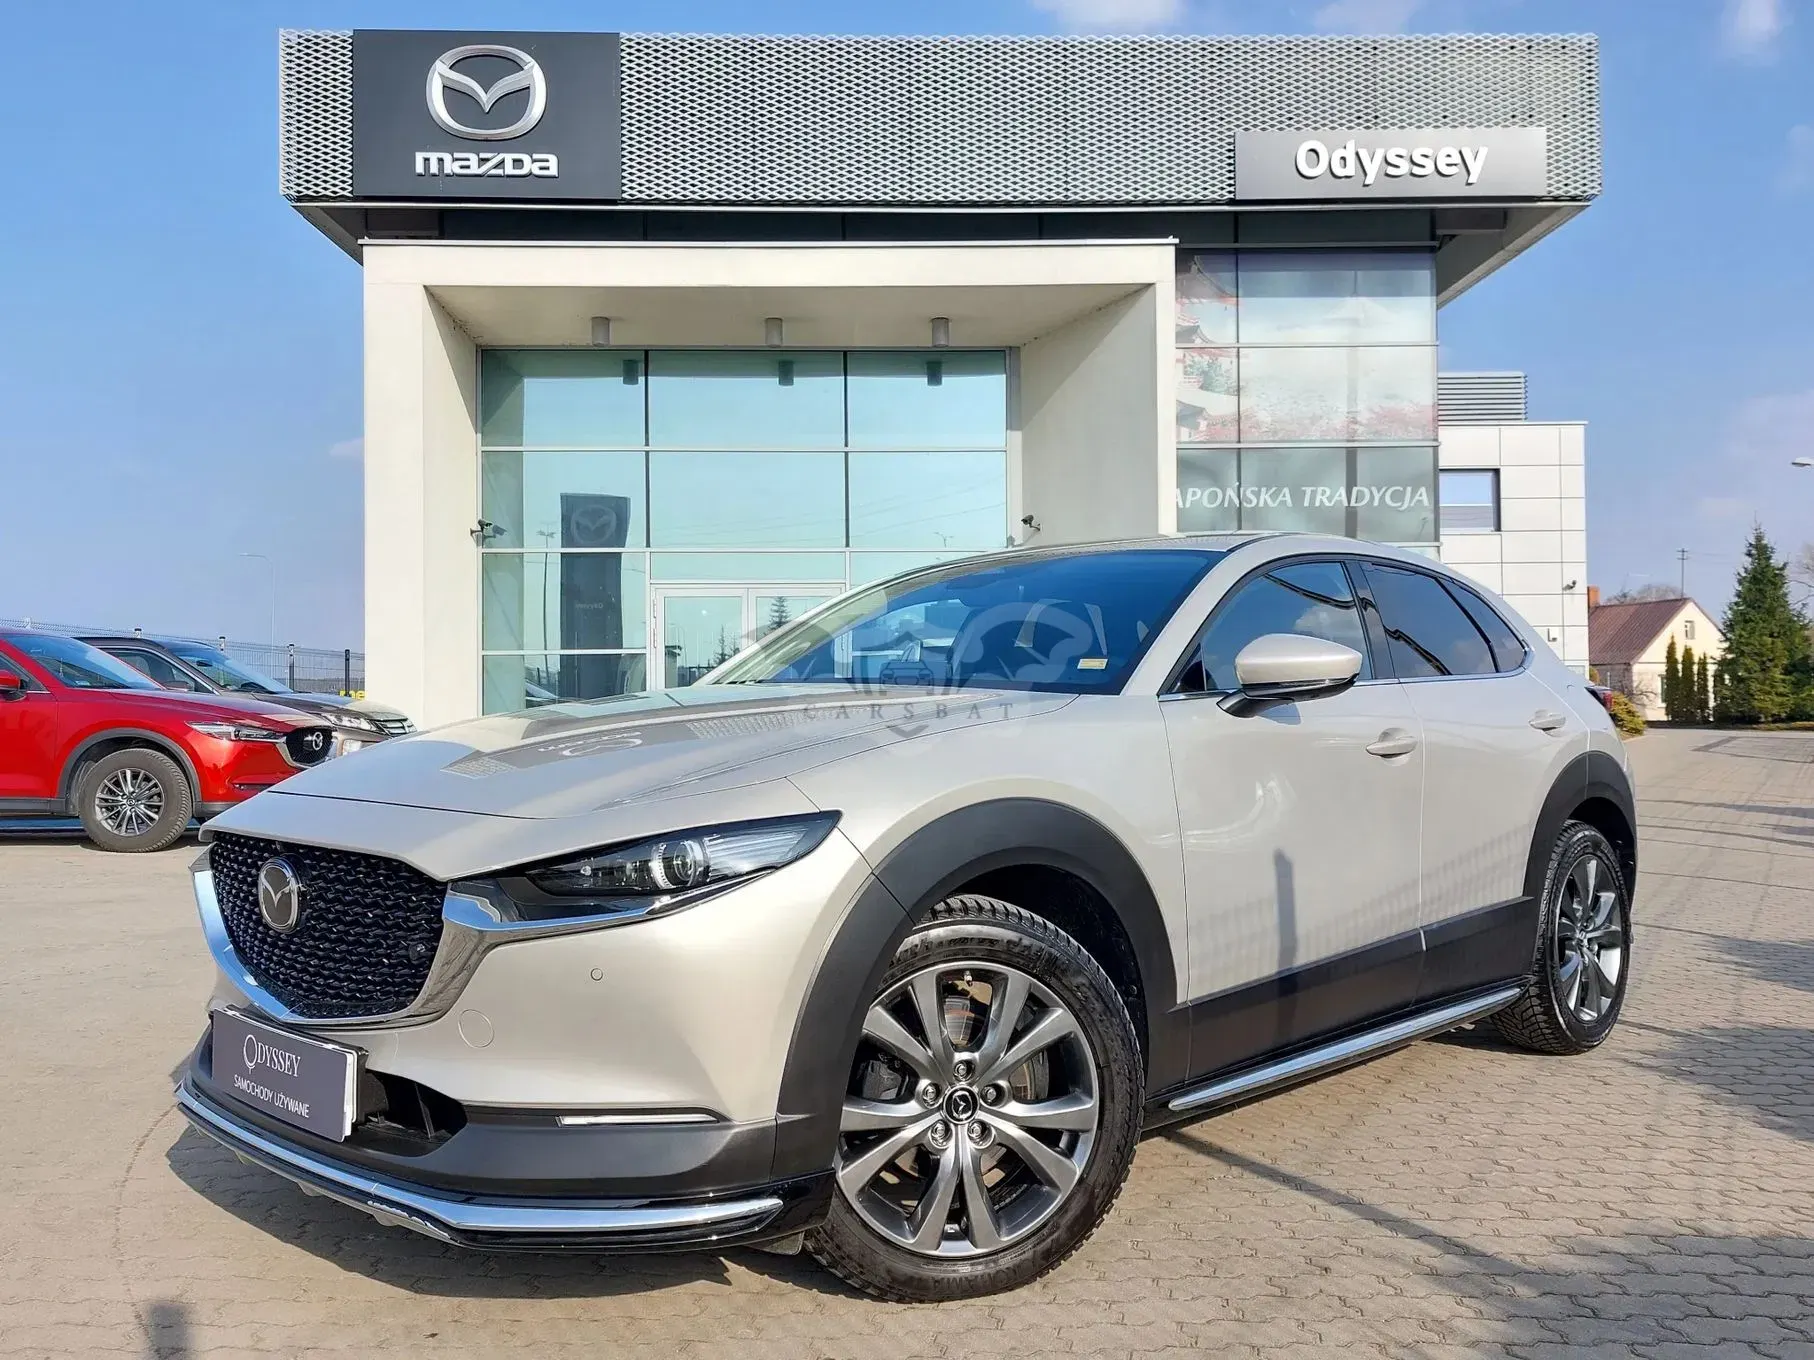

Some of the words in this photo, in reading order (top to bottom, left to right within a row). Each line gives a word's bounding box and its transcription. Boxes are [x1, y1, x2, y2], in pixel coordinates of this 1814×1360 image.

[1294, 139, 1489, 186] Odyssey
[1302, 485, 1430, 511] TRADYCJA
[244, 1034, 301, 1077] ODYSSEY
[234, 1074, 273, 1103] SAMOCHODY
[274, 1092, 310, 1118] UŻYWANE
